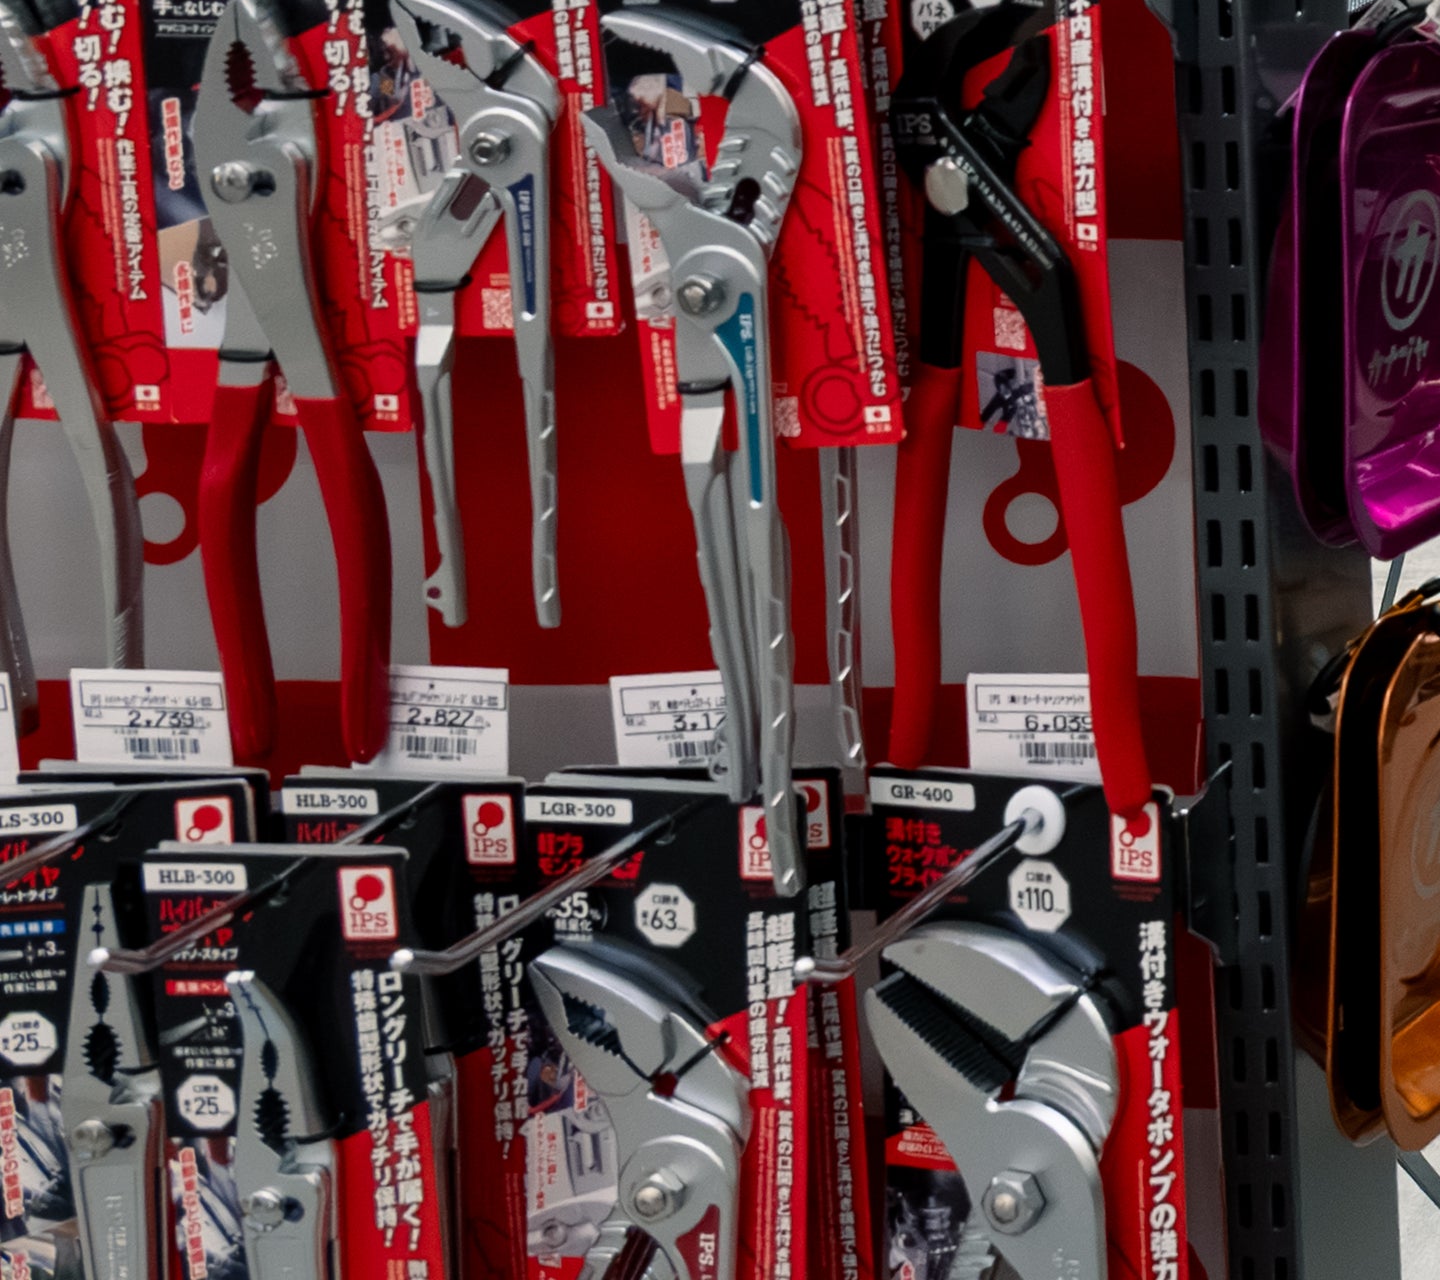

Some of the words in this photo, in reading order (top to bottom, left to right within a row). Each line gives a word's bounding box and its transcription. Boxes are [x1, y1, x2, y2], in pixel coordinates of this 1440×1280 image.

[295, 793, 369, 812] HLB-300
[890, 784, 955, 804] GR-400
[471, 837, 509, 856] IPS
[1118, 849, 1155, 869] IPS
[158, 869, 236, 888] HLB-300
[350, 910, 390, 931] IPS
